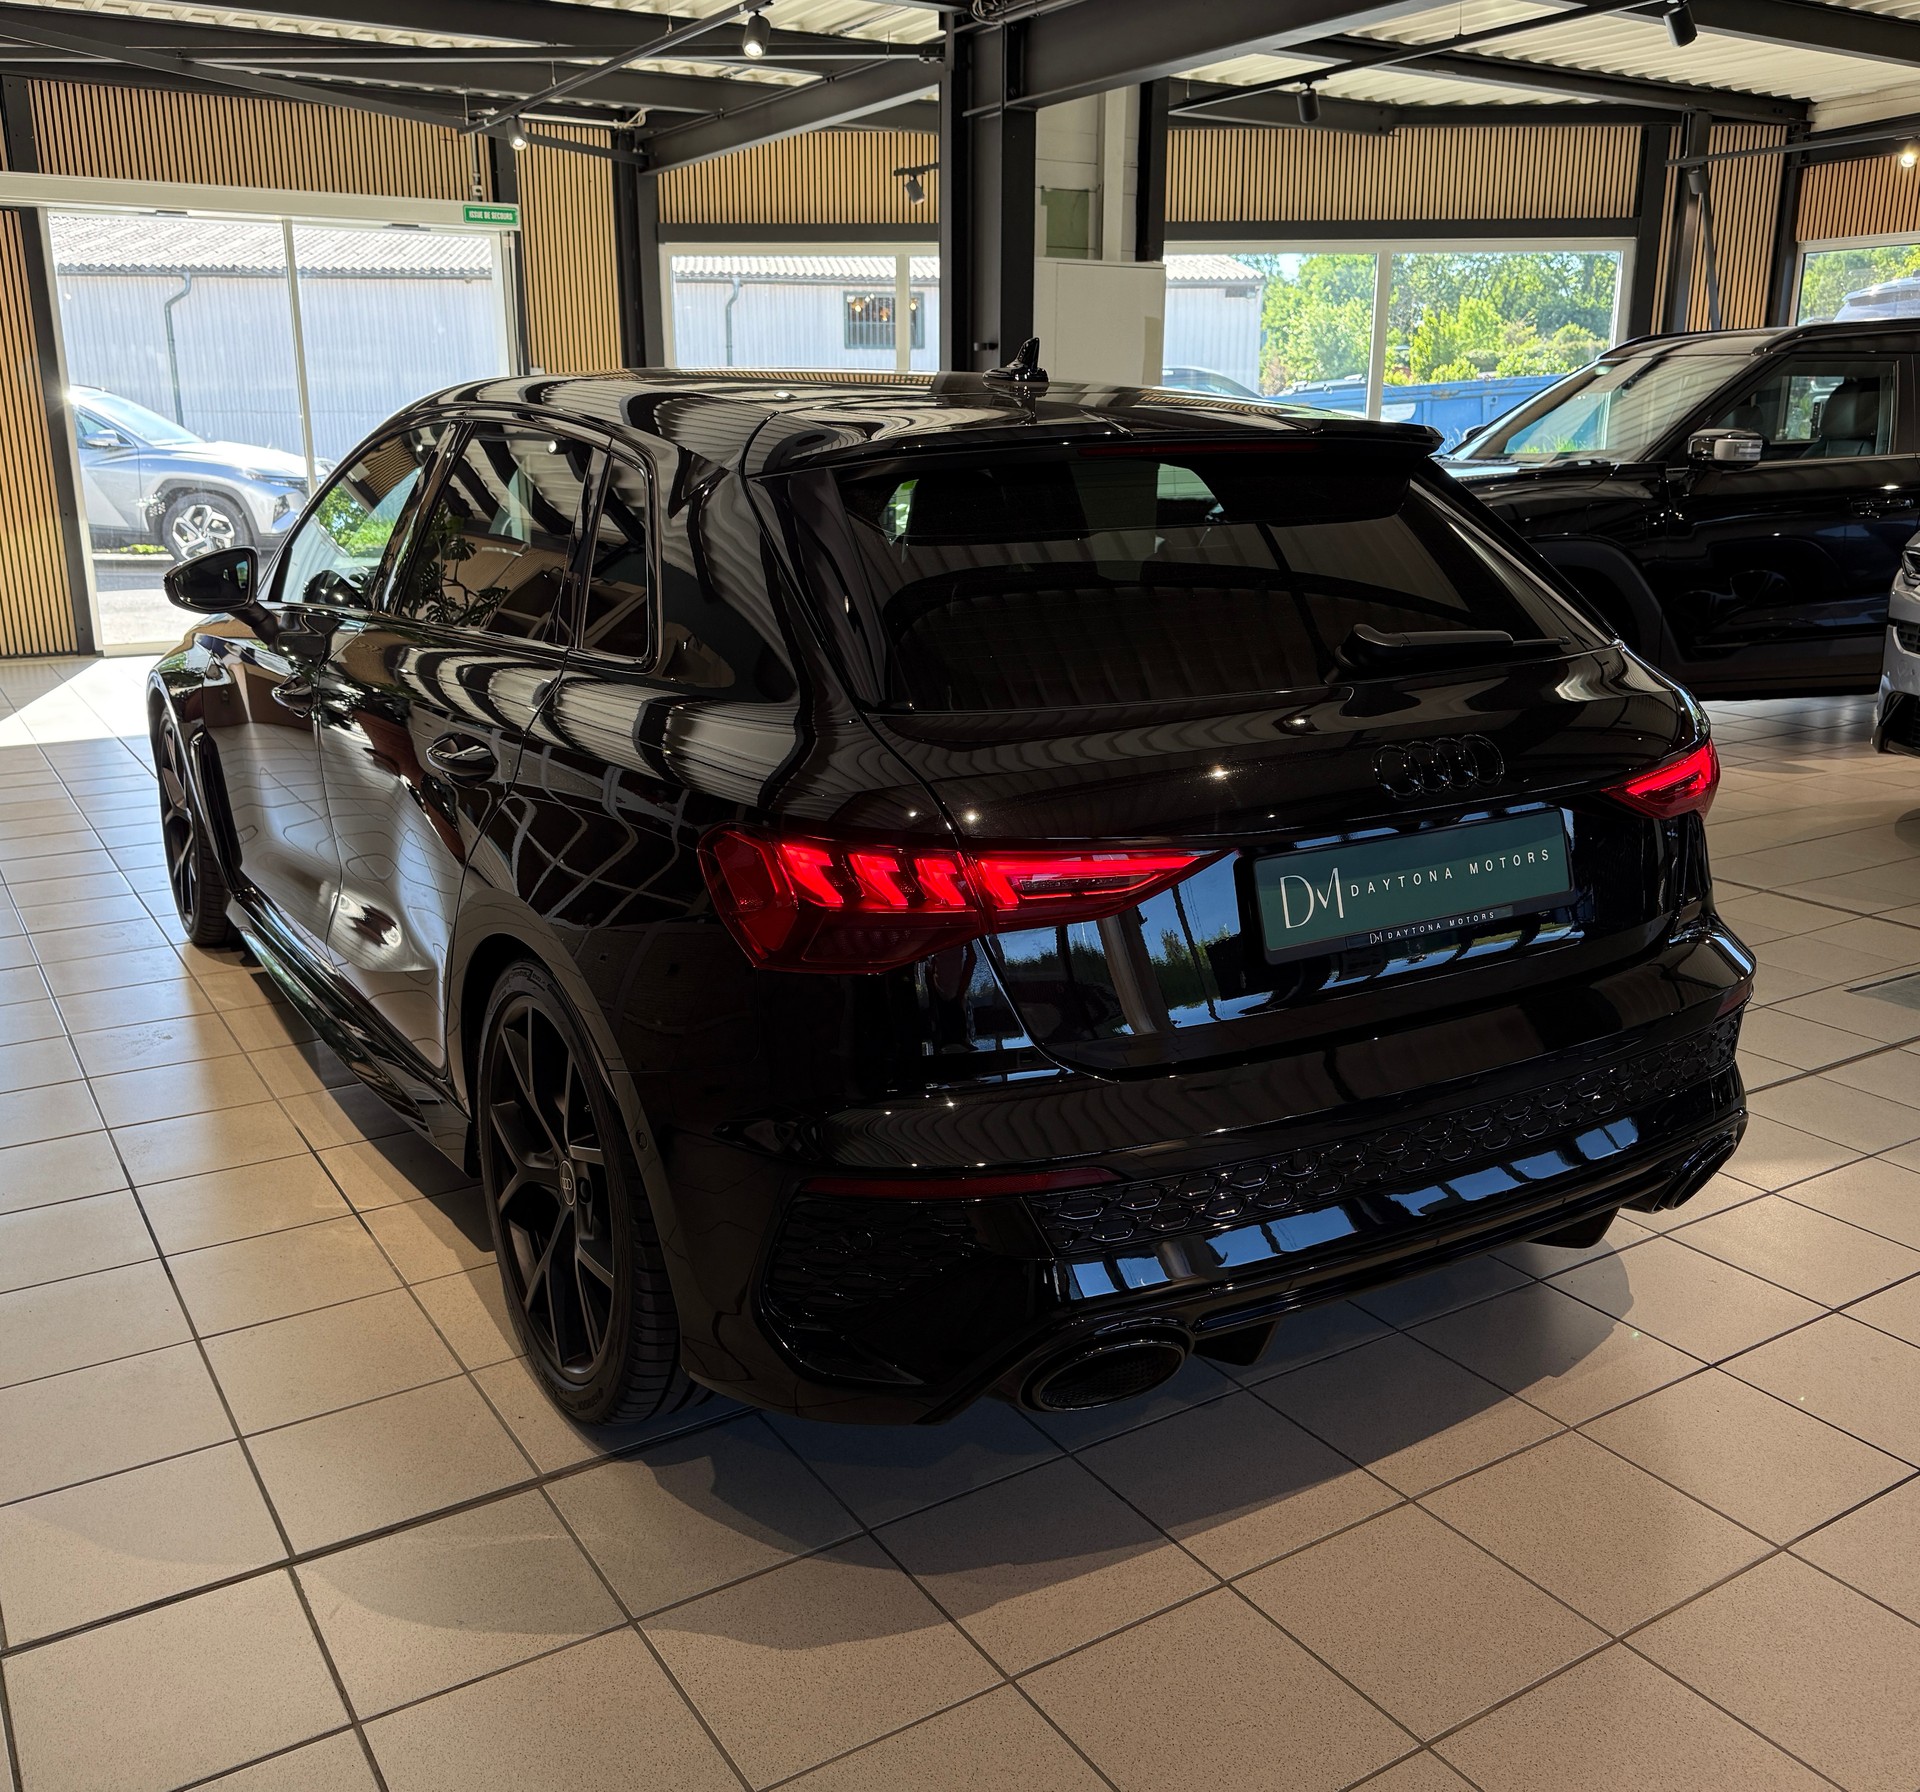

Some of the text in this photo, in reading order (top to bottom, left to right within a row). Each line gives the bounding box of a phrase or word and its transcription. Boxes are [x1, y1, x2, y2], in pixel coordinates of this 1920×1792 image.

[1350, 867, 1453, 897] DAYTONA
[1469, 849, 1549, 875] MOTORS
[1387, 922, 1442, 939] DAYTONA
[1449, 911, 1494, 927] MOTORS
